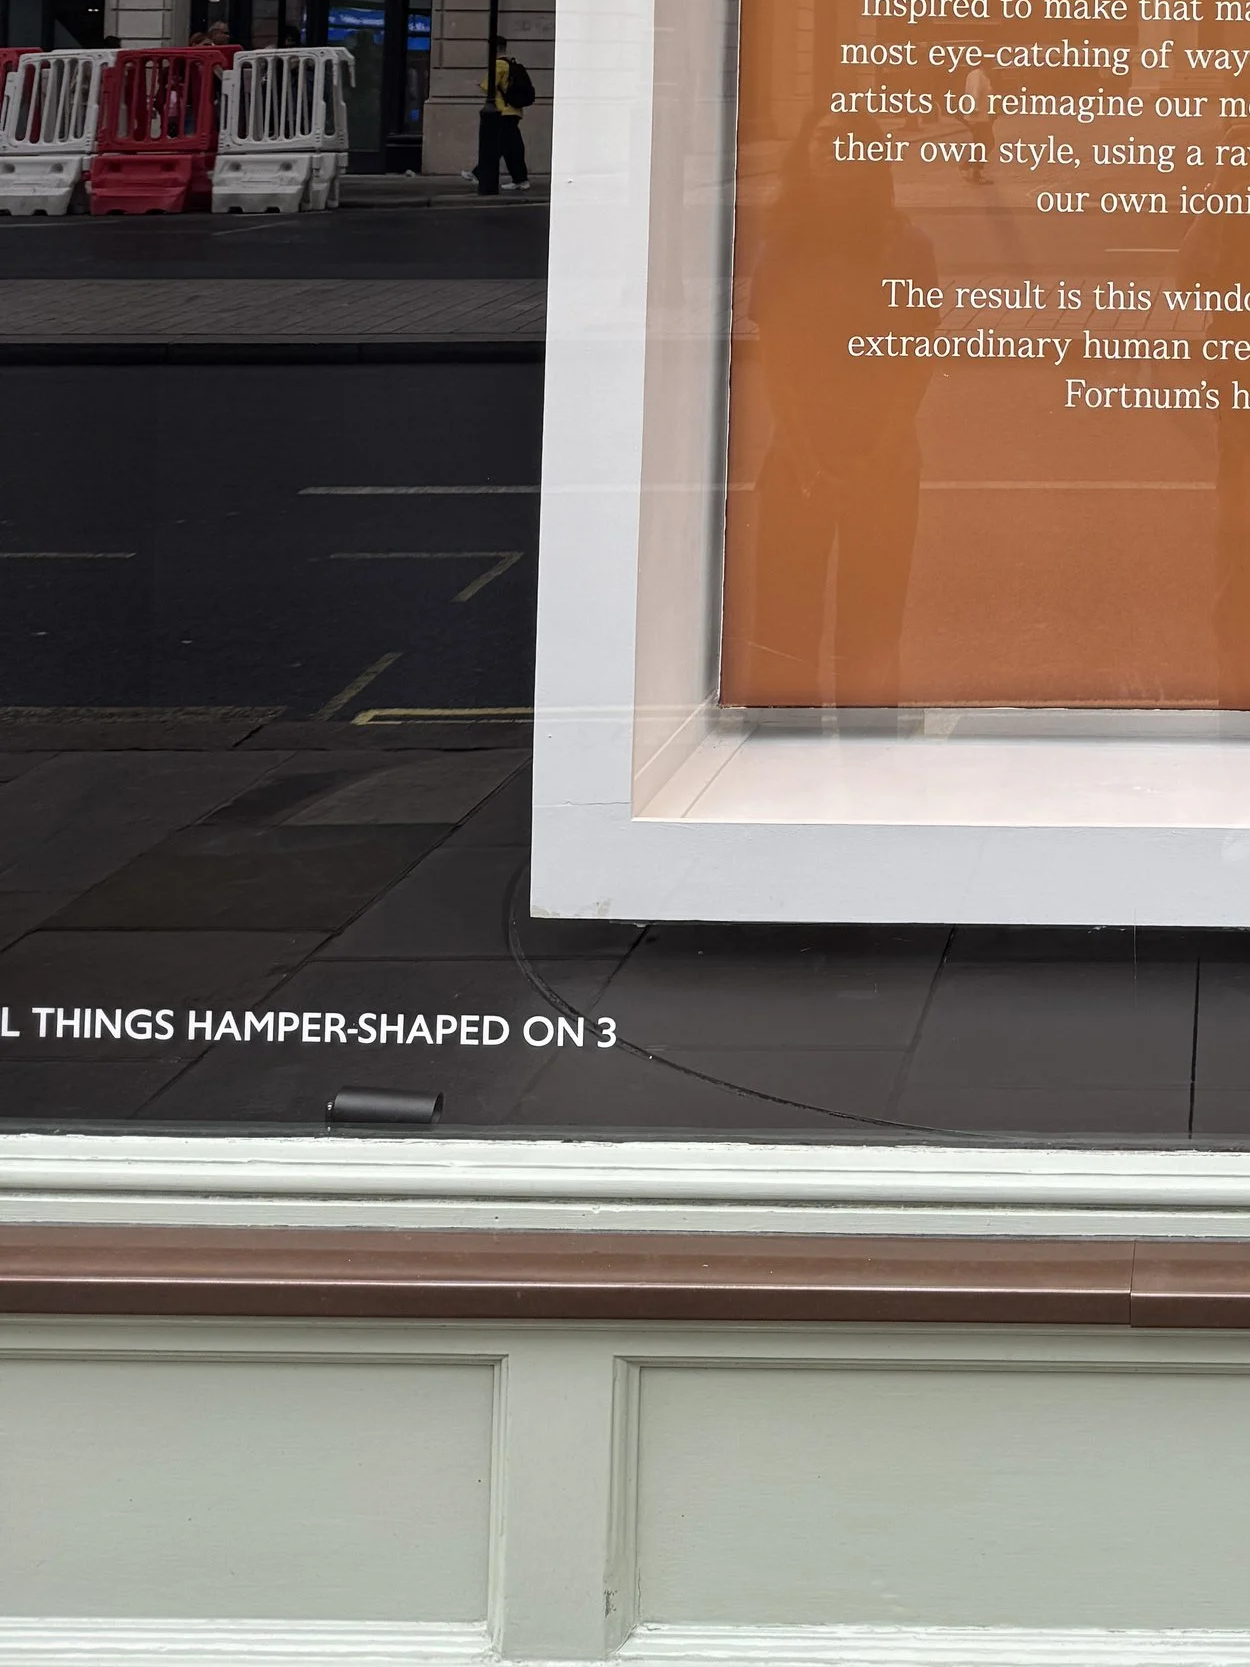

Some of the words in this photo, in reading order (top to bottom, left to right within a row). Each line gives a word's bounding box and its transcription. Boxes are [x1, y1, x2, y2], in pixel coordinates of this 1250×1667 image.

[840, 40, 918, 66] most
[928, 38, 1131, 76] eye-catching
[1140, 40, 1175, 69] of
[830, 84, 933, 114] artists
[943, 89, 976, 115] to
[987, 86, 1144, 124] reimagine
[1155, 96, 1209, 118] our
[832, 132, 910, 162] their
[920, 141, 988, 163] own
[999, 134, 1081, 171] style,
[1092, 136, 1176, 173] using
[1186, 145, 1205, 166] a
[1036, 191, 1090, 213] our
[1100, 192, 1169, 214] own
[881, 278, 944, 309] The
[955, 280, 1047, 310] result
[1057, 280, 1082, 310] is
[1092, 281, 1152, 311] this
[847, 328, 1073, 366] extraordinary
[1082, 329, 1192, 360] human
[31, 1007, 175, 1041] THINGS
[187, 1009, 510, 1046] HAMPER-SHAPED
[522, 1015, 585, 1048] ON
[596, 1016, 617, 1049] 3
